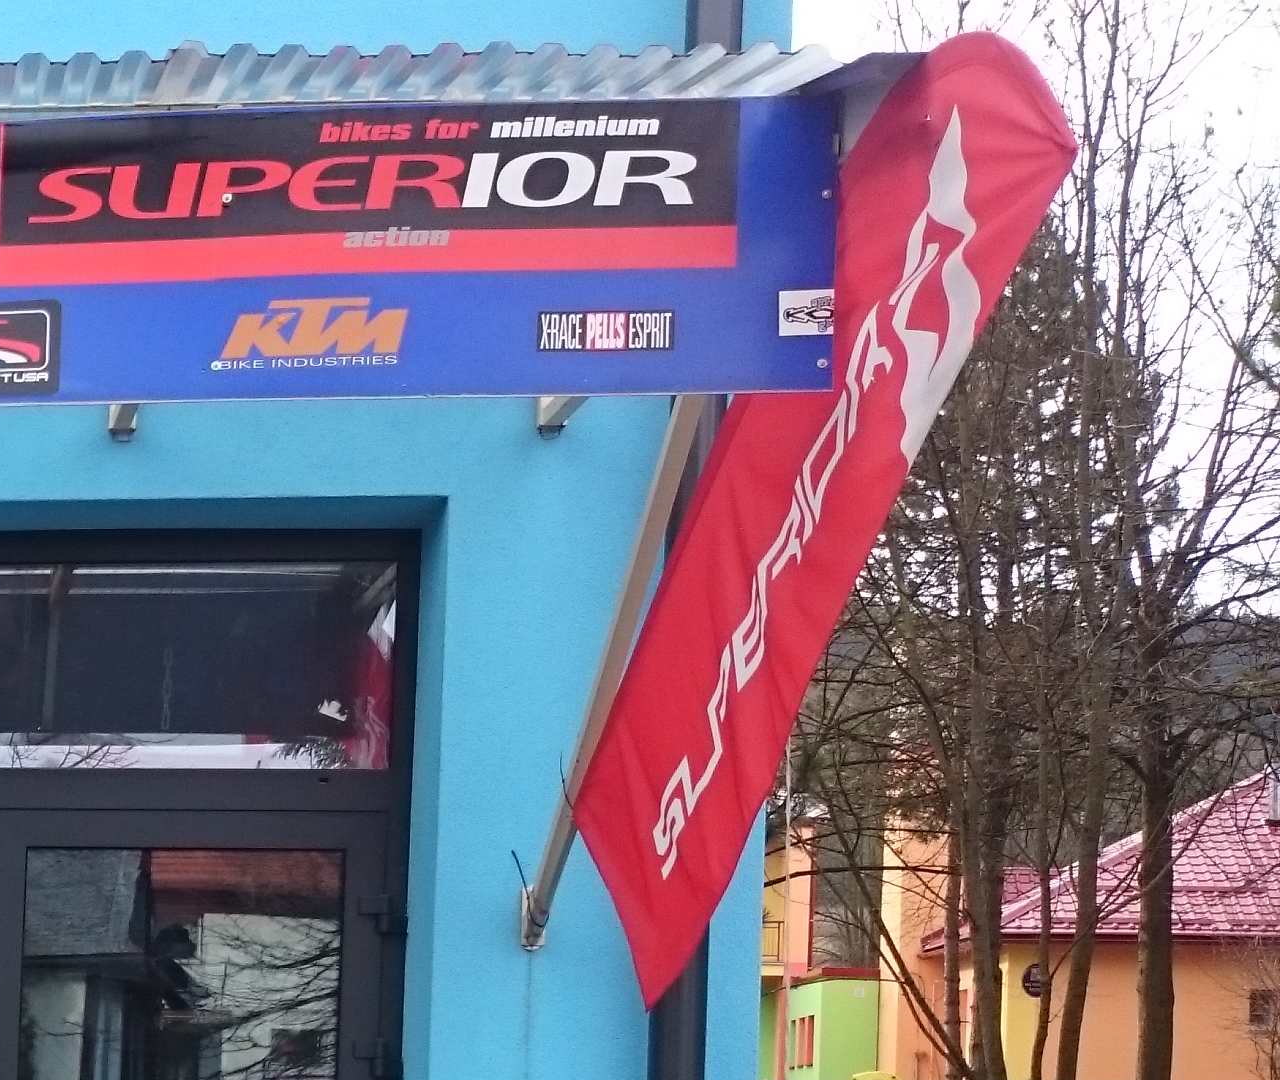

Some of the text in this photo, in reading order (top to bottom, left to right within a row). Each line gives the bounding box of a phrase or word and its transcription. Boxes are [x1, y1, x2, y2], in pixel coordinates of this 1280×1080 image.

[319, 115, 660, 144] bikes for millenium
[28, 149, 697, 224] SUPERIOR
[343, 226, 450, 249] action
[221, 296, 408, 359] KTM
[628, 311, 671, 350] ESPRIT
[13, 371, 49, 384] USA
[219, 355, 398, 371] BIKE INDUSTRIES
